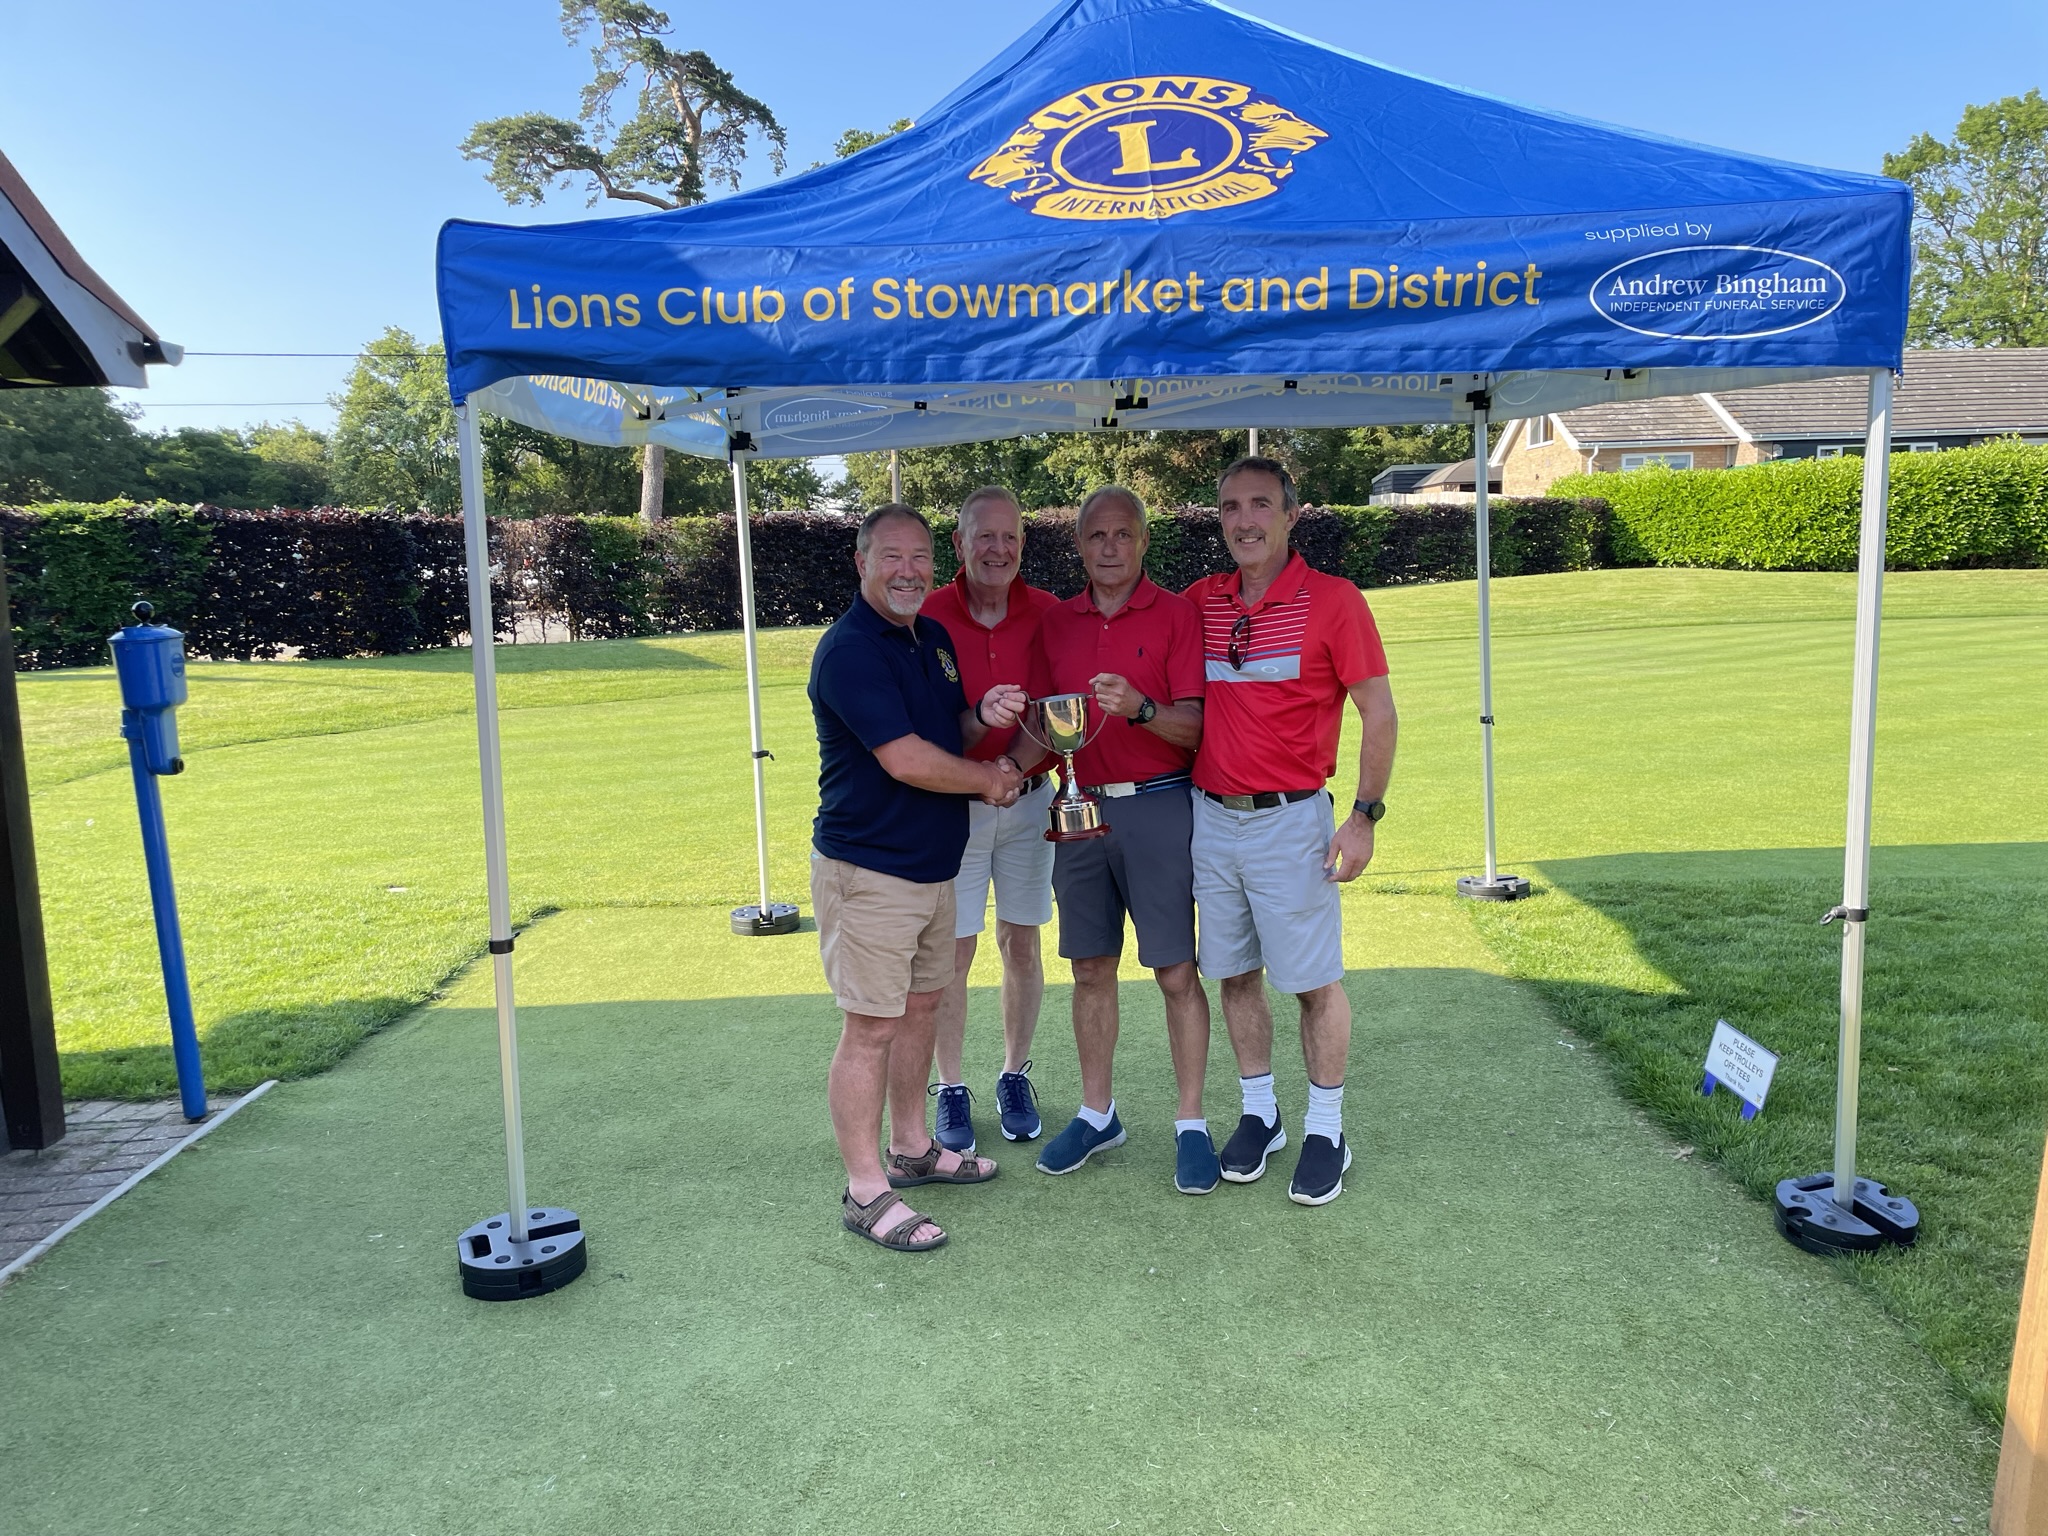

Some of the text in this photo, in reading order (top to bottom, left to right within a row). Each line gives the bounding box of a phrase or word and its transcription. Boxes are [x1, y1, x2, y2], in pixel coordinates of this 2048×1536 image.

[1043, 79, 1240, 122] LIONS
[1108, 120, 1201, 175] L
[1050, 180, 1260, 214] INTERNATIONAL
[1585, 221, 1713, 243] supplied by
[509, 261, 1543, 329] Lions Club of Stowmarket and District
[1608, 272, 1828, 299] Andrew Bingham
[1610, 298, 1825, 312] INDEPENDENT FUNERAL SERVICE
[1719, 1042, 1764, 1078] KEEP TROLLEYS
[1733, 1038, 1756, 1059] PLEASE
[1724, 1059, 1751, 1083] OFF TEES
